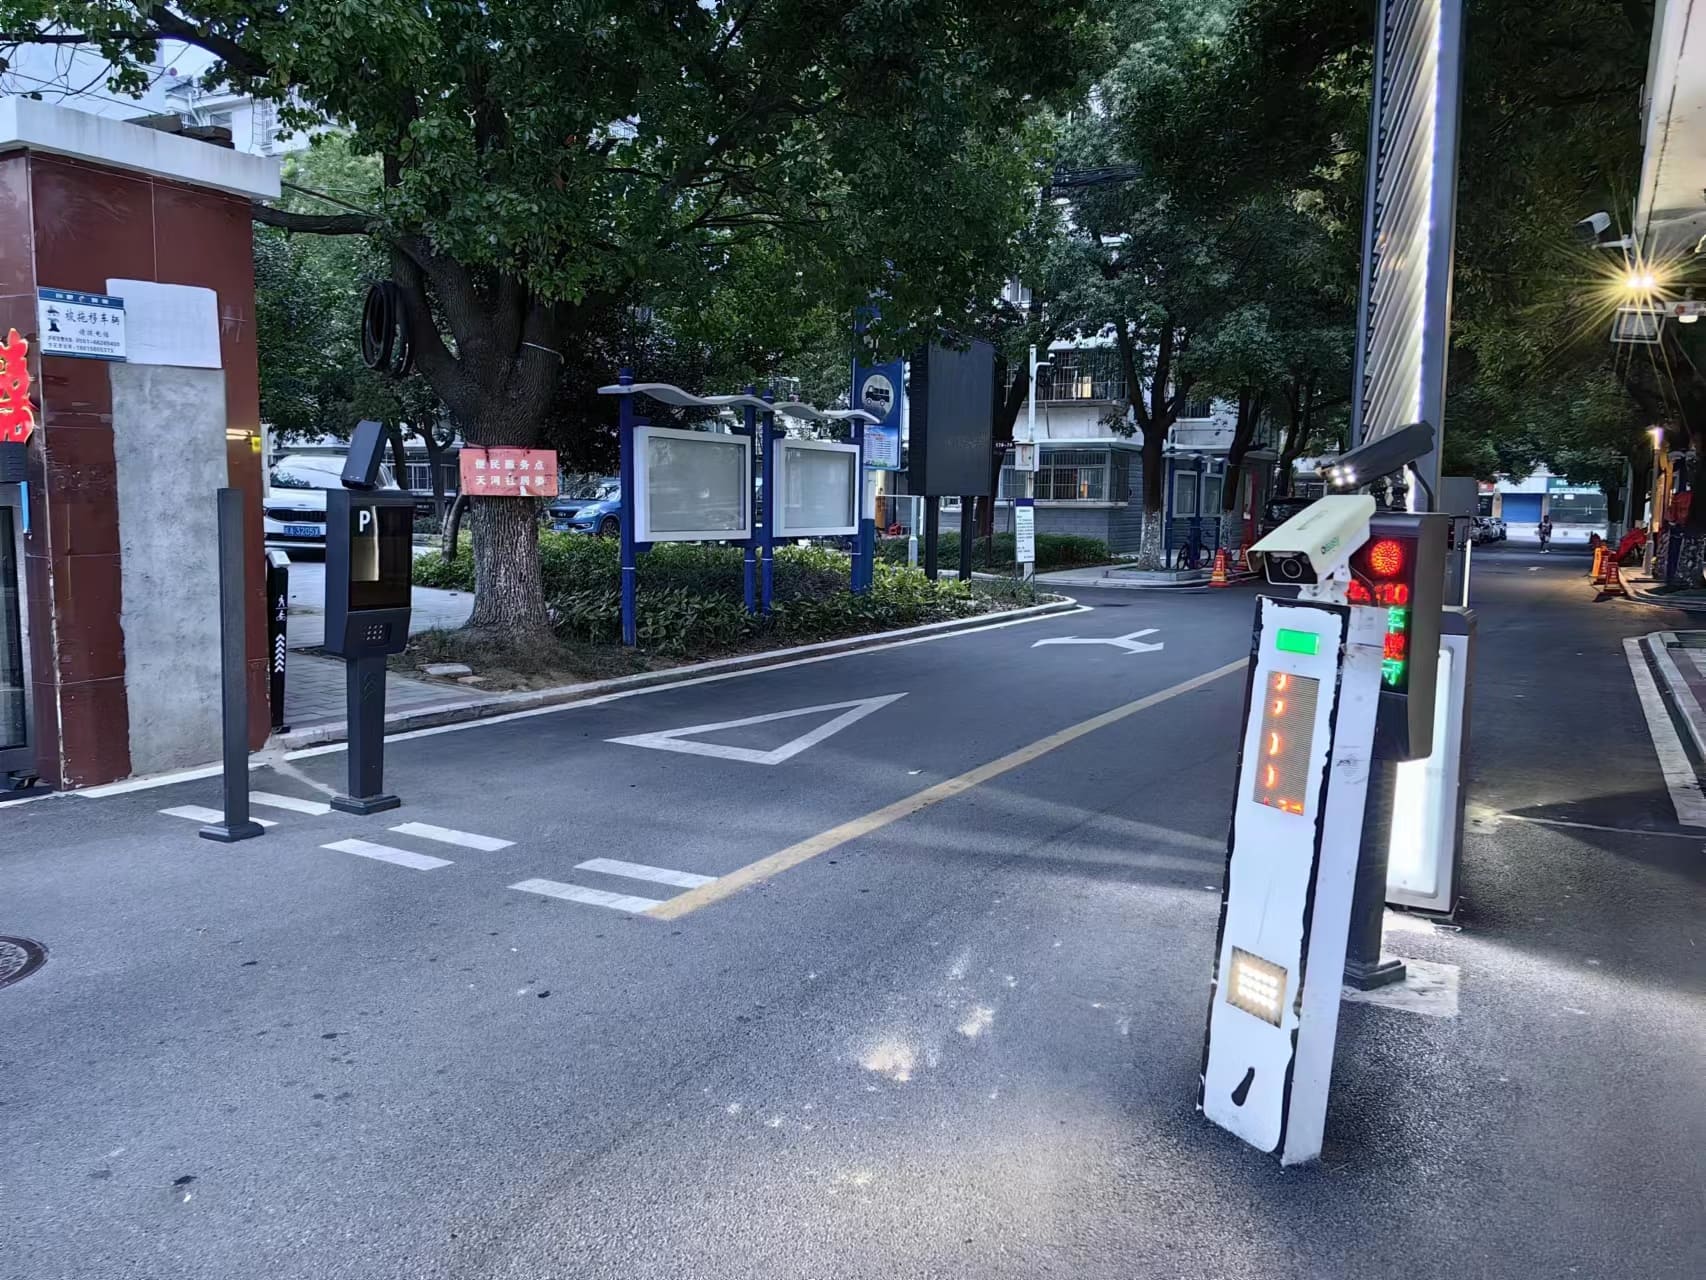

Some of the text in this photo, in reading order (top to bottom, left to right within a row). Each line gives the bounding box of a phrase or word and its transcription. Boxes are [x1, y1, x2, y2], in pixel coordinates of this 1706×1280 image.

[475, 459, 545, 470] 便民服务点
[359, 510, 371, 532] P
